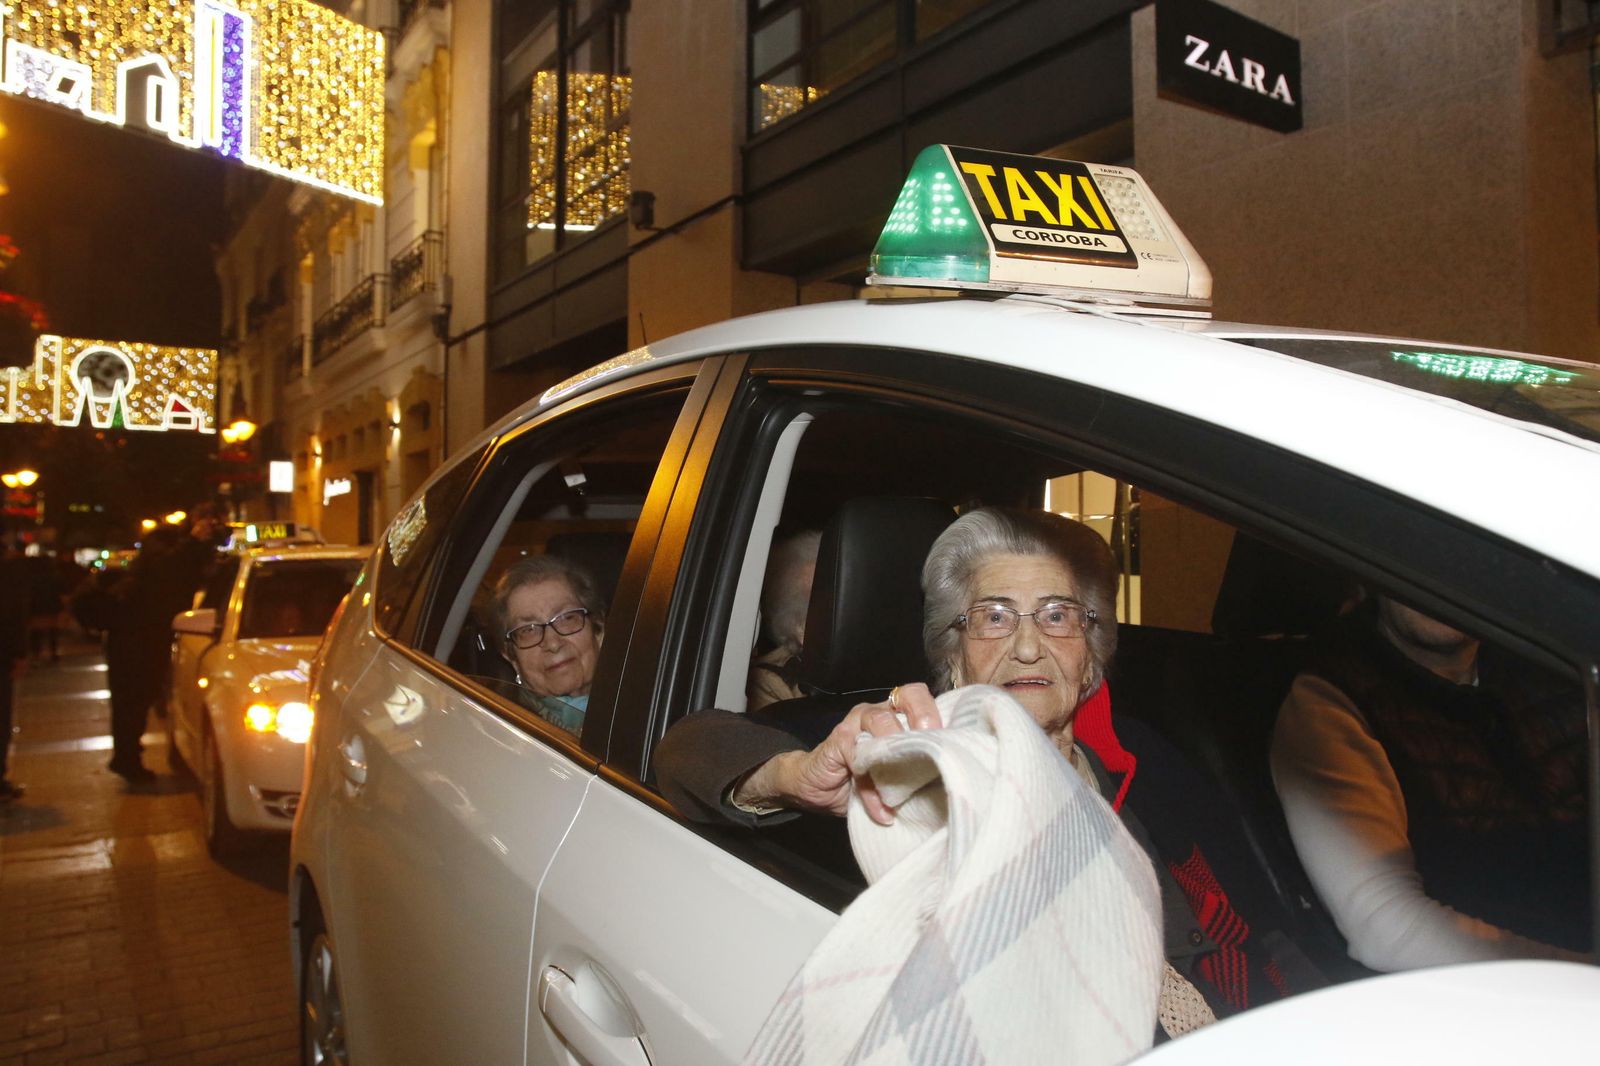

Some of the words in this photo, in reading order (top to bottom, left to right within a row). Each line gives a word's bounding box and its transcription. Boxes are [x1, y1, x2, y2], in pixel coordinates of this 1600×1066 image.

[1184, 34, 1296, 106] ZARA
[960, 161, 1115, 232] TAXI
[1012, 229, 1108, 248] CORDOBA
[259, 523, 288, 539] TAXI
